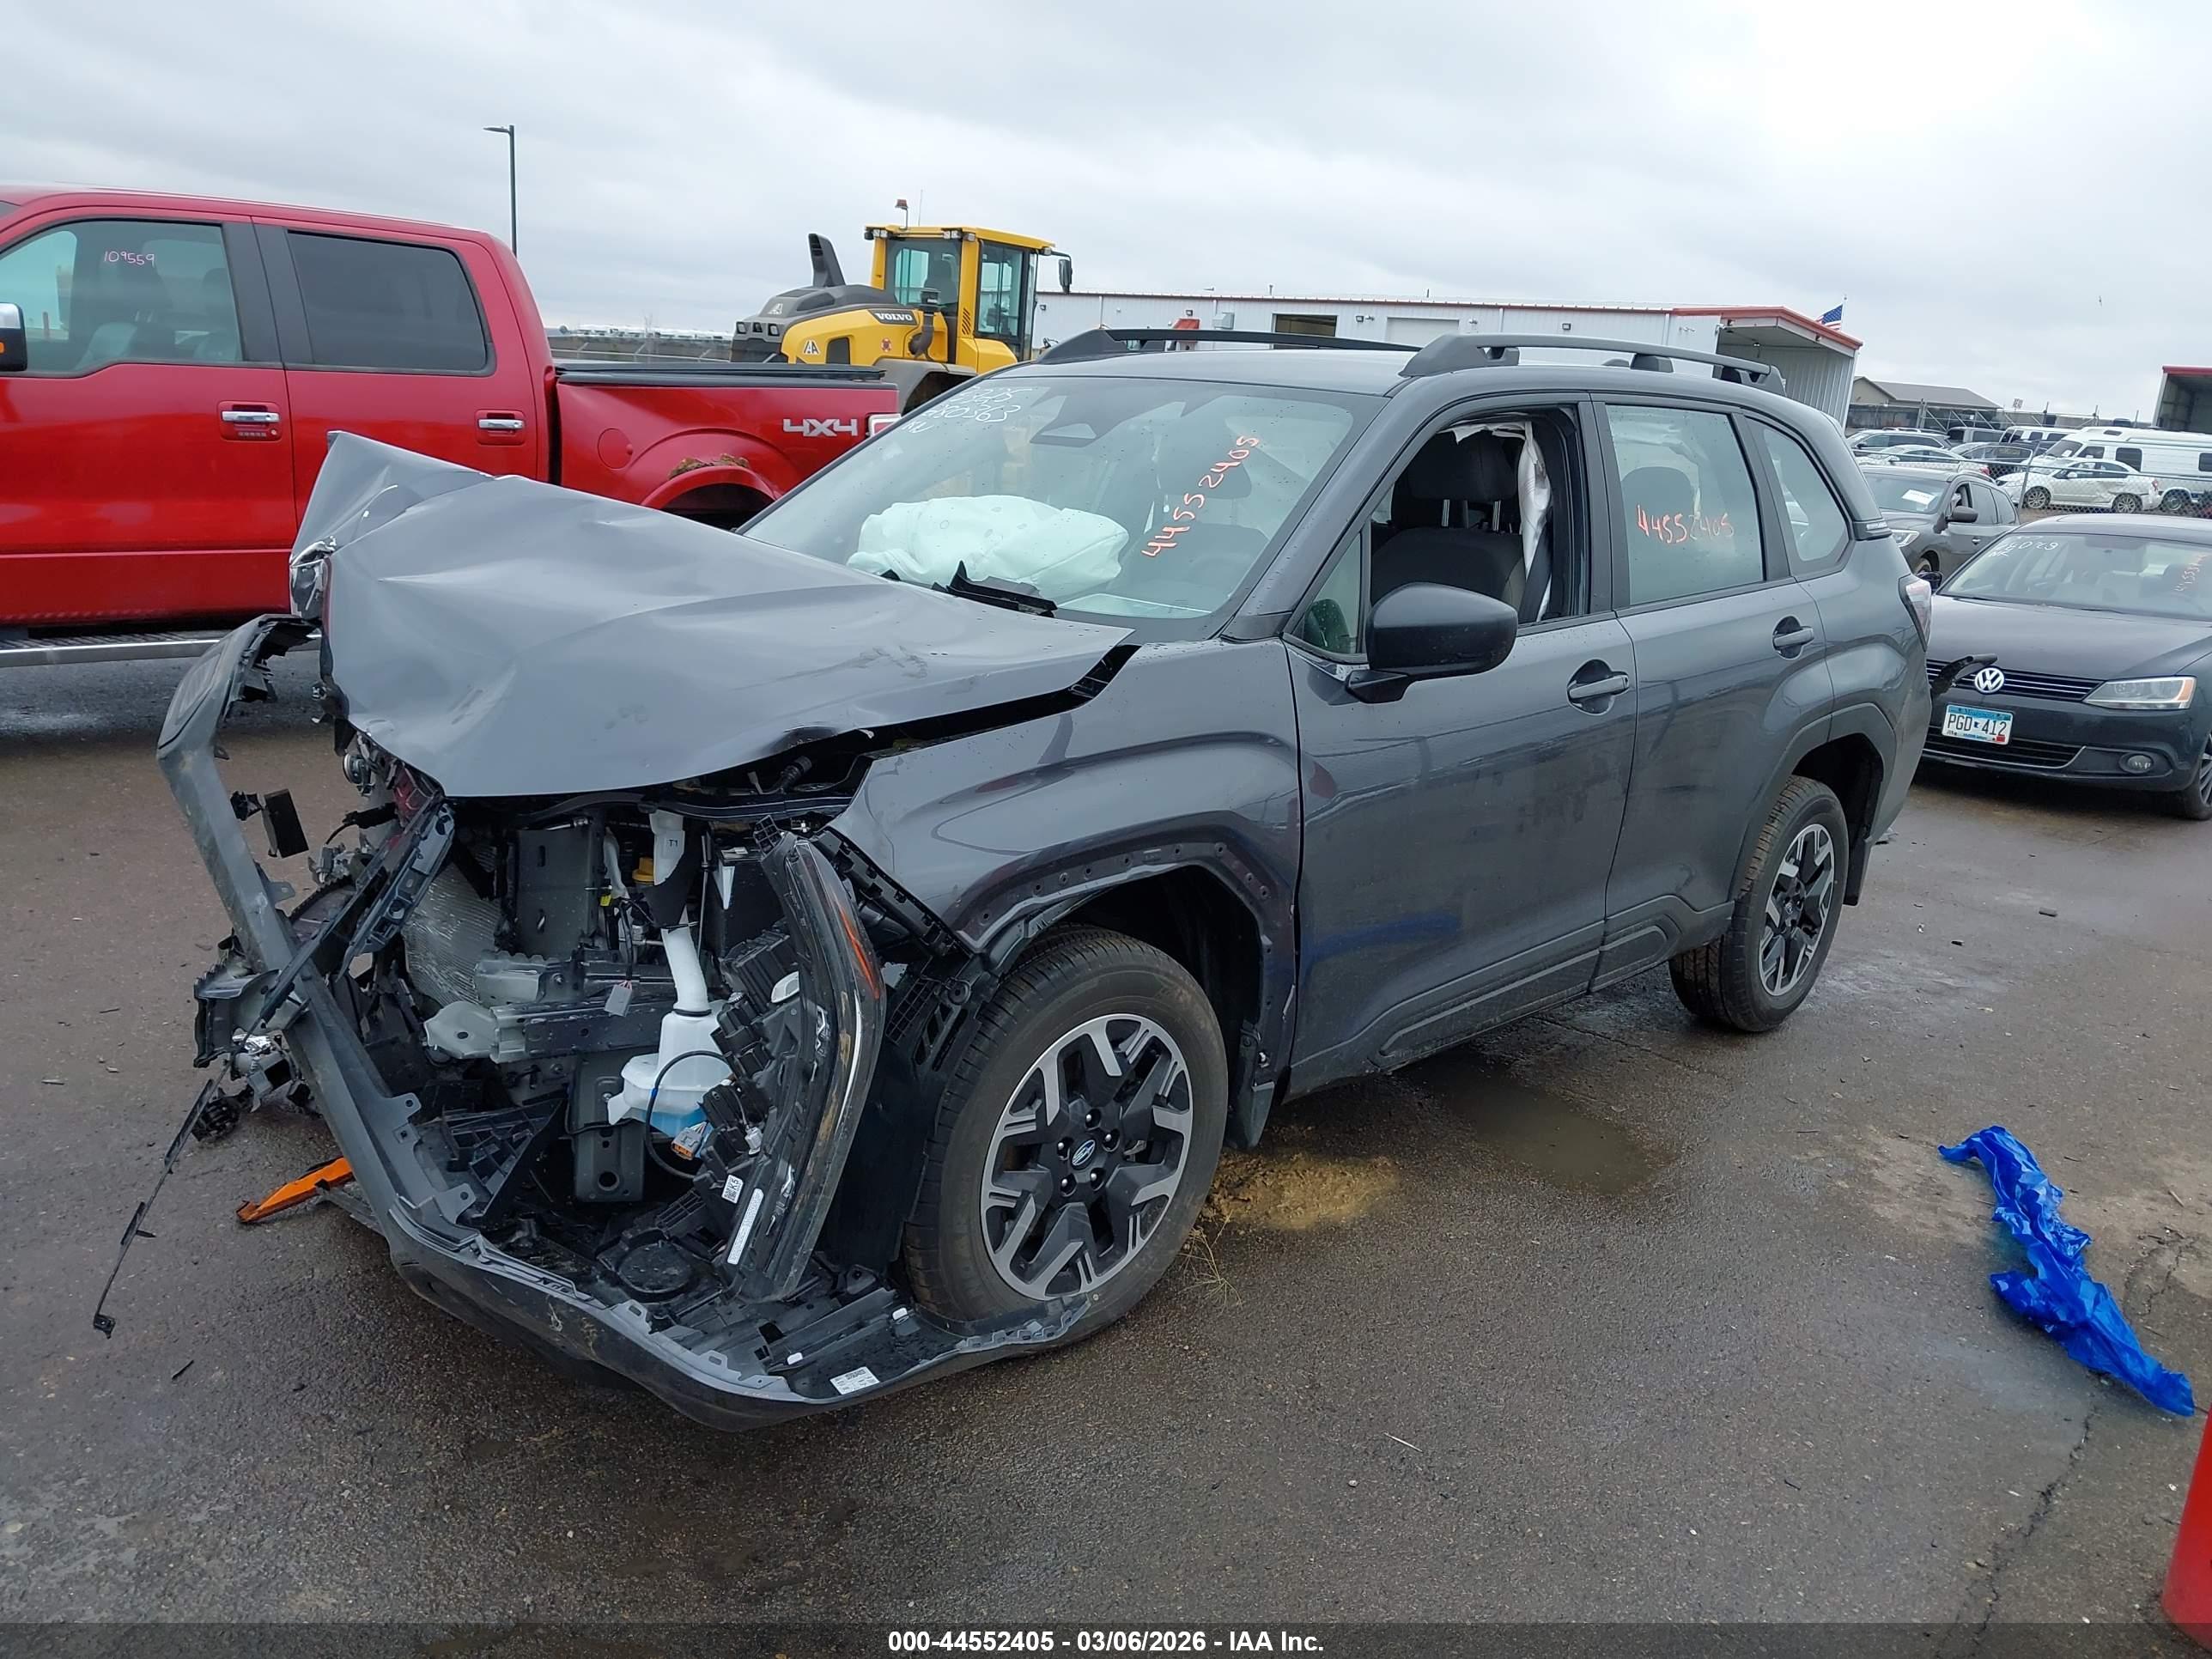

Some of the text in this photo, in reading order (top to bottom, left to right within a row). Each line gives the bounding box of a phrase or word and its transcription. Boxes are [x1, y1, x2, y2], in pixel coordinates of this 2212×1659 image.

[104, 250, 155, 268] 109559
[875, 313, 913, 321] VOLVO
[1140, 434, 1261, 558] 44552405
[1637, 504, 1735, 544] 44552405
[1947, 714, 2008, 736] PGD 412
